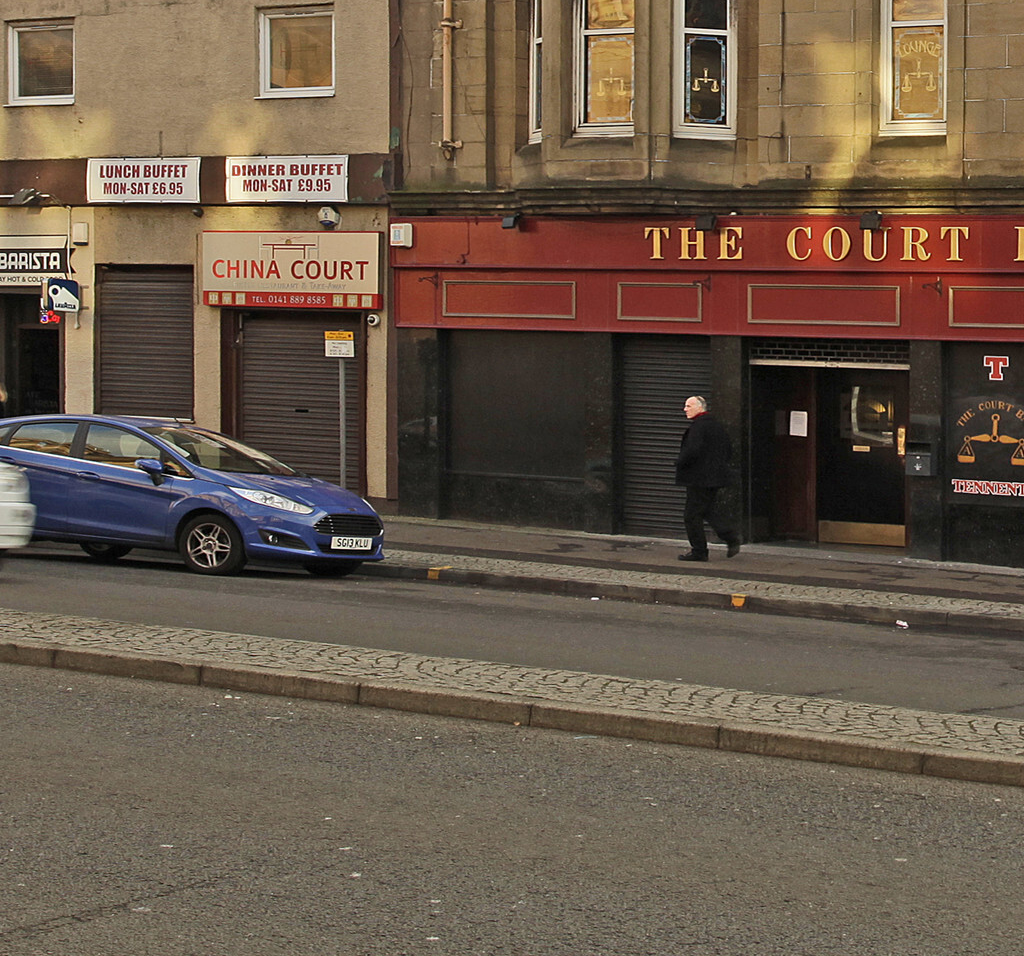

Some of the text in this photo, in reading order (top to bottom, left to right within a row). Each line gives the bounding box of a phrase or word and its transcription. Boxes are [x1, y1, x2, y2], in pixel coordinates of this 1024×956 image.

[898, 40, 943, 58] LOUNGE
[99, 164, 188, 179] LUNCH BUFFET
[231, 163, 344, 177] DINNER BUFFET
[103, 182, 183, 195] MON-SAT £6.95
[242, 178, 331, 192] MON-SAT £9.95
[644, 226, 743, 261] THE
[786, 225, 970, 262] COURT
[0, 252, 60, 270] BARISTA
[212, 259, 369, 280] CHINA COURT
[268, 295, 288, 304] 0141
[290, 296, 304, 304] 889
[306, 296, 326, 304] 8585
[984, 356, 1009, 380] T
[956, 408, 976, 428] THE
[978, 400, 1014, 412] COURT
[337, 538, 368, 548] SG13 KLU
